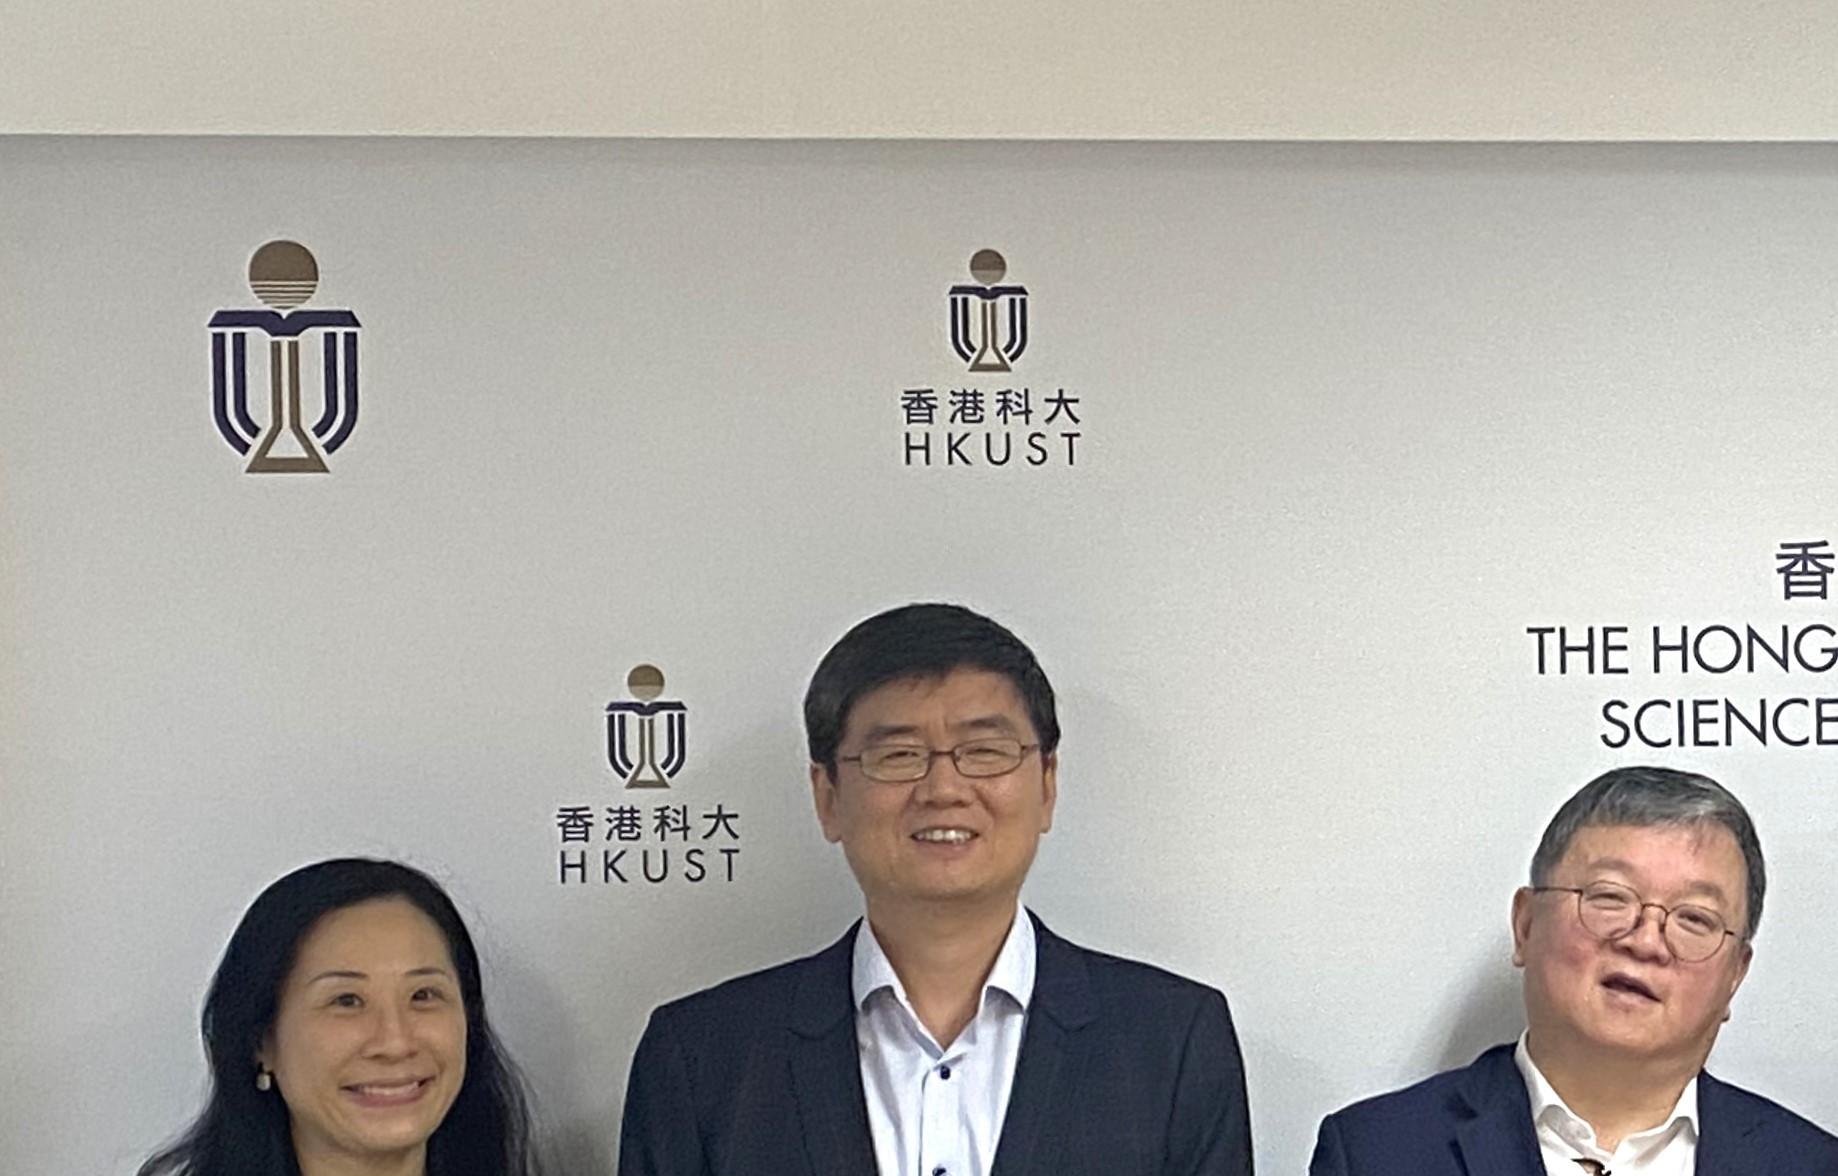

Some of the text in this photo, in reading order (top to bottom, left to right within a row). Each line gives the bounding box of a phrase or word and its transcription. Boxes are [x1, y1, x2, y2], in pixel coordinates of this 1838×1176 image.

[900, 387, 1081, 426] 香港科大
[905, 431, 1081, 466] HKUST
[1526, 626, 1629, 675] THE
[556, 804, 740, 843] 香港科大
[560, 848, 740, 884] HKUST
